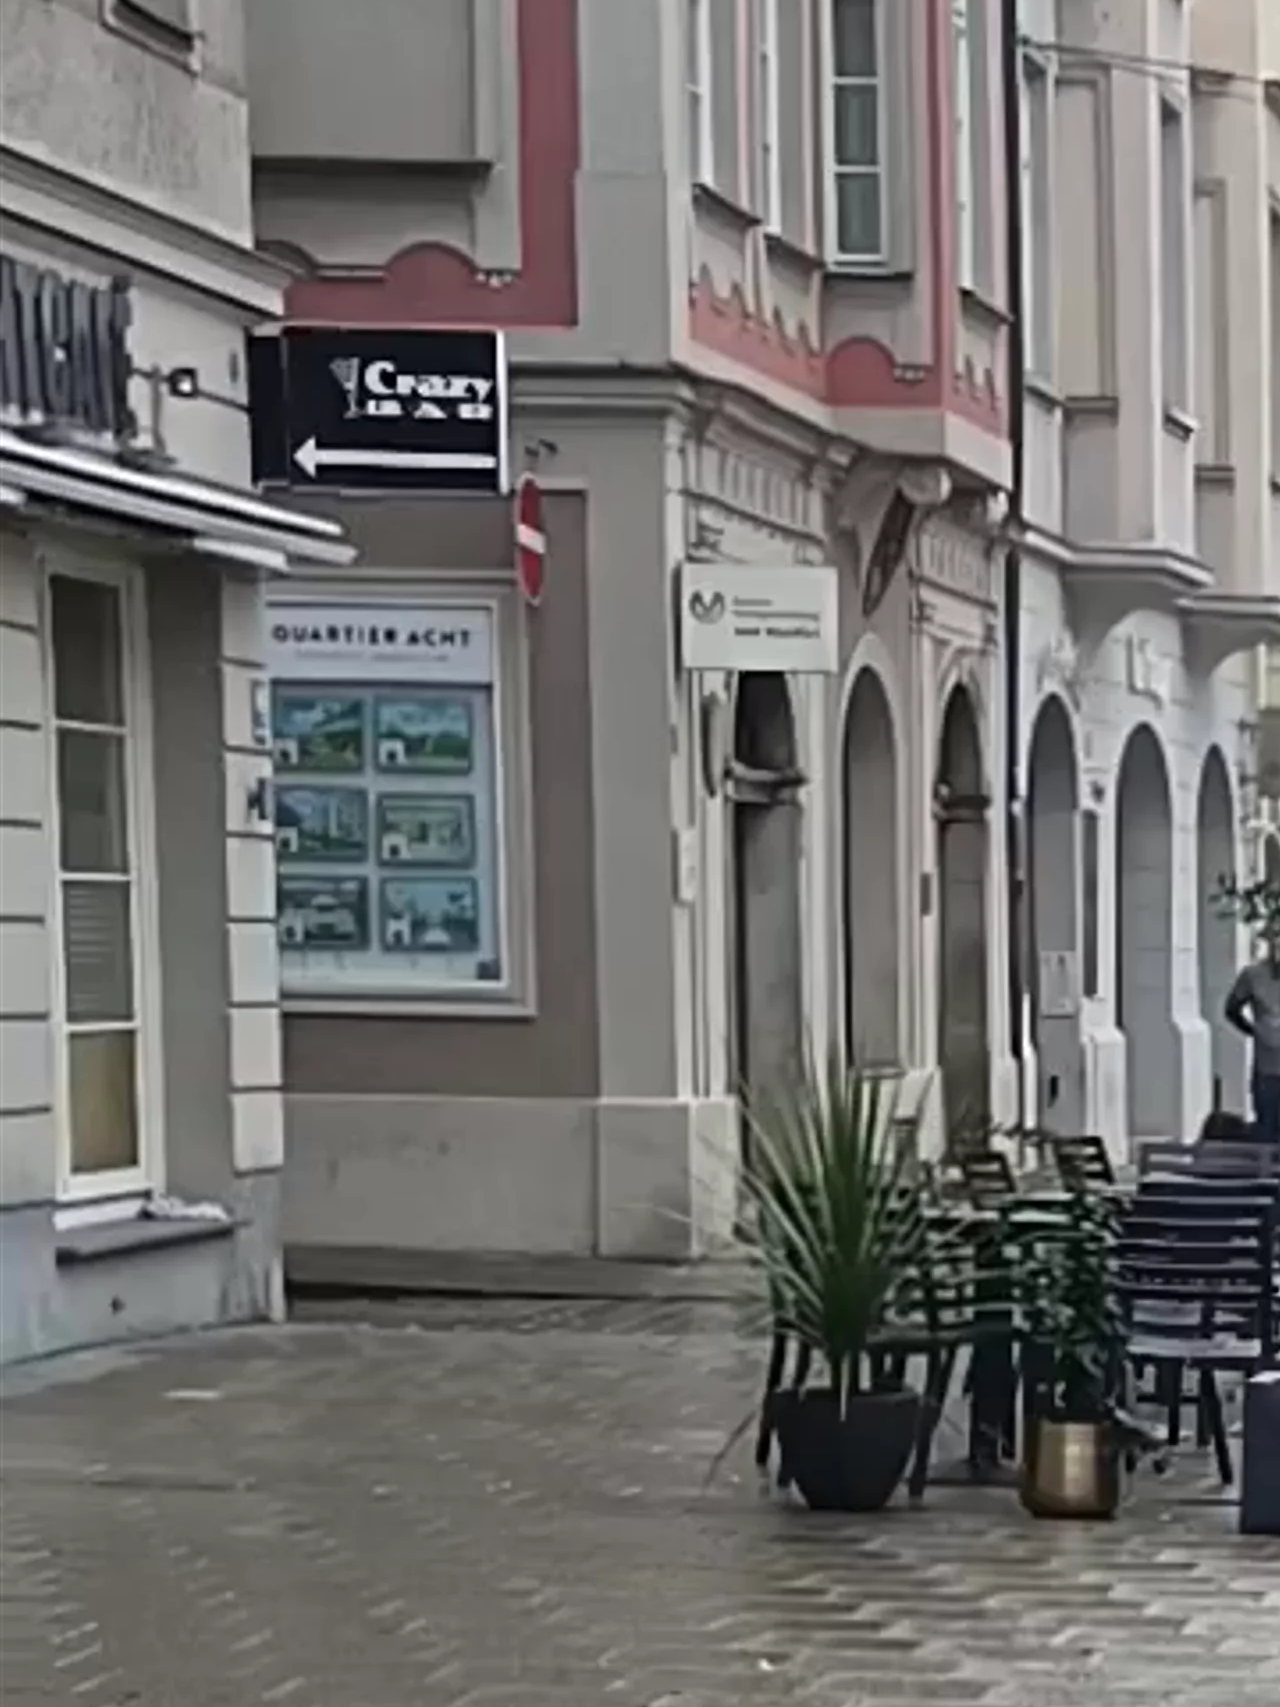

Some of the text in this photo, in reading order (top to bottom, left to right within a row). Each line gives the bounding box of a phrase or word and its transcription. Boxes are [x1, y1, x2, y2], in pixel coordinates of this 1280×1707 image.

[364, 359, 494, 404] Crazy
[271, 623, 471, 647] QUARTIER ACHT
